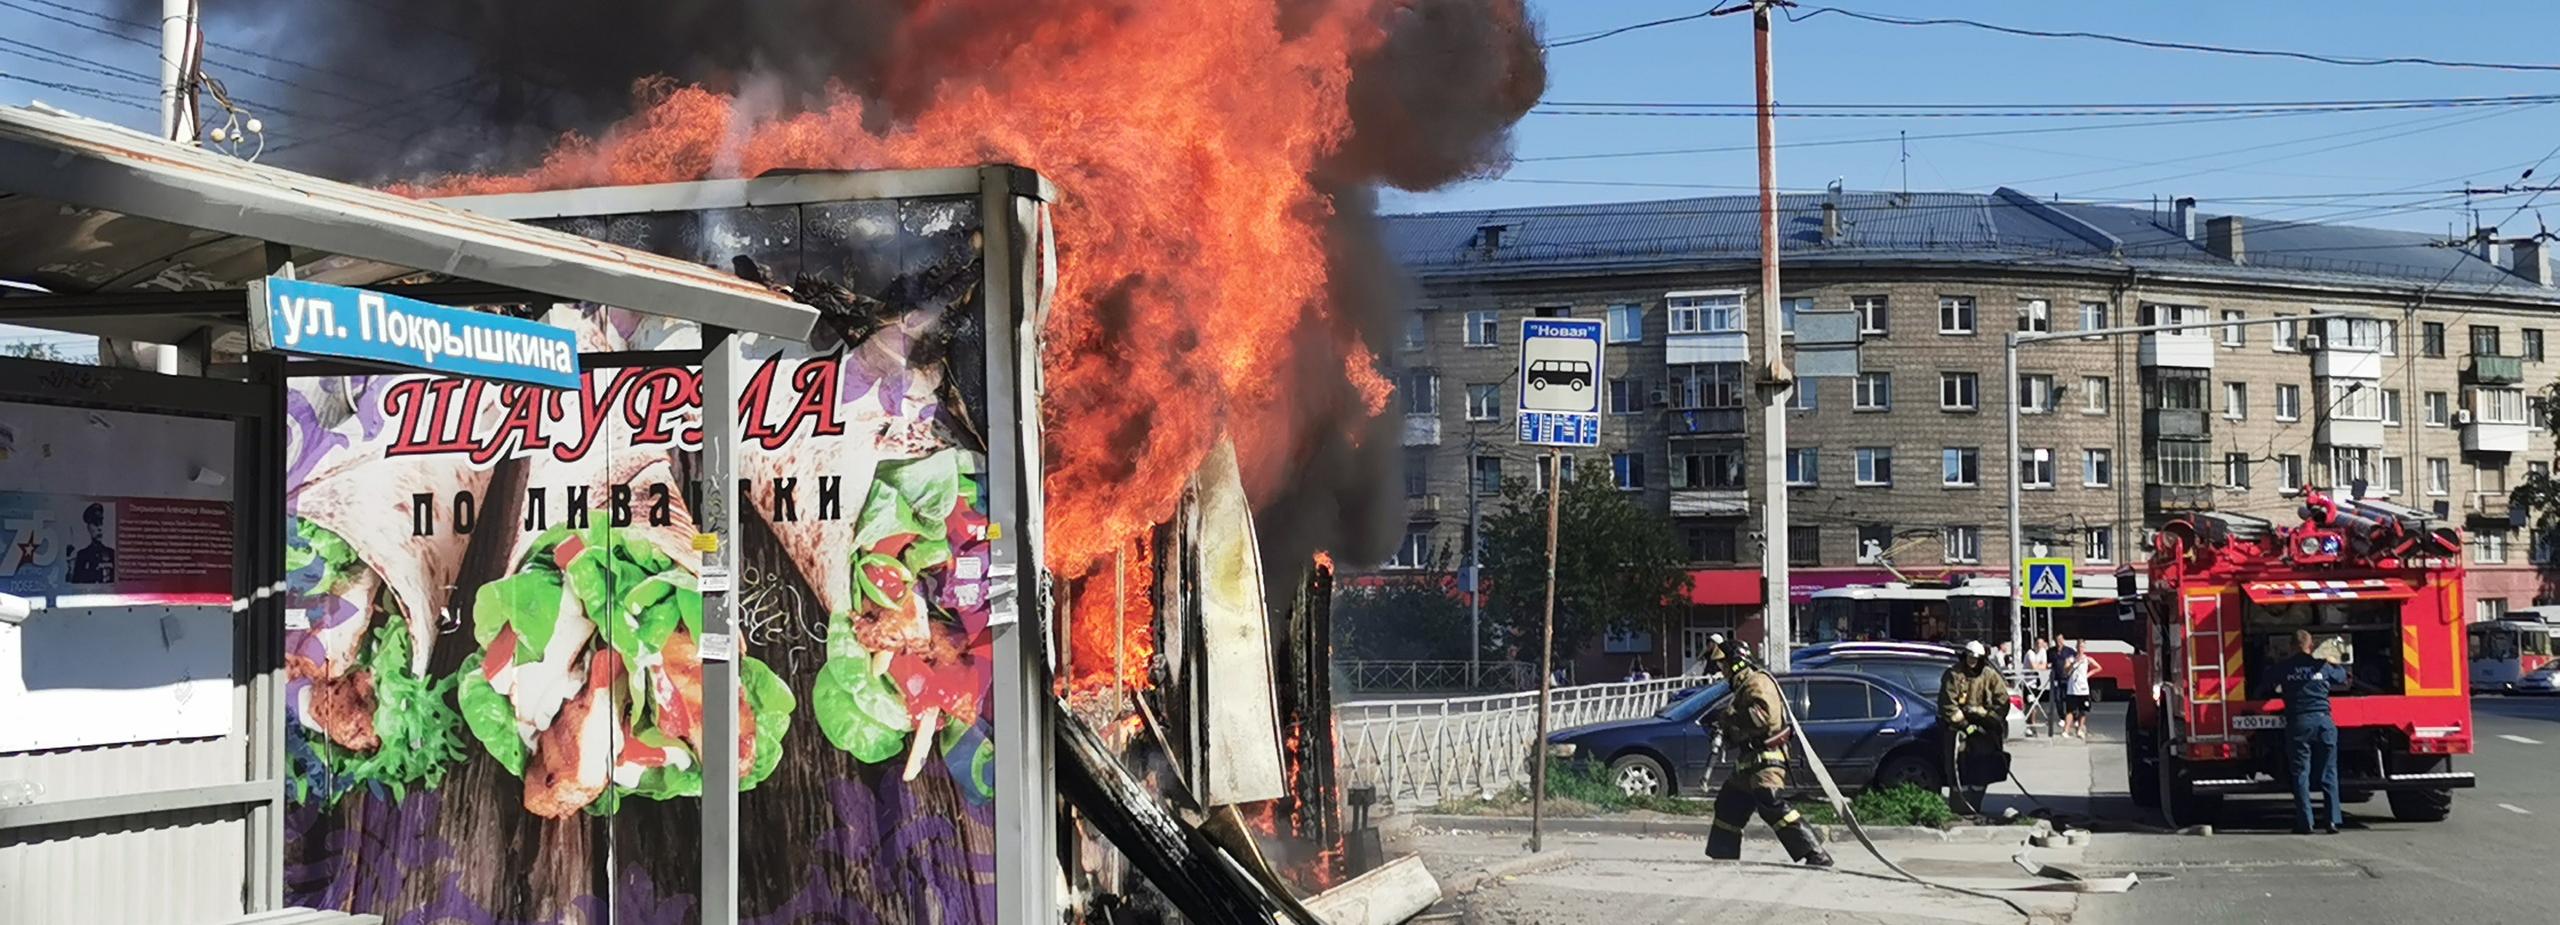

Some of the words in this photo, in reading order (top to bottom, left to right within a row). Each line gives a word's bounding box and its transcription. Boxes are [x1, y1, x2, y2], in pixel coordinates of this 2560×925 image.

[280, 294, 348, 346] ул.
[357, 293, 573, 374] Покрышкина
[0, 510, 59, 577] 75
[412, 490, 478, 537] по
